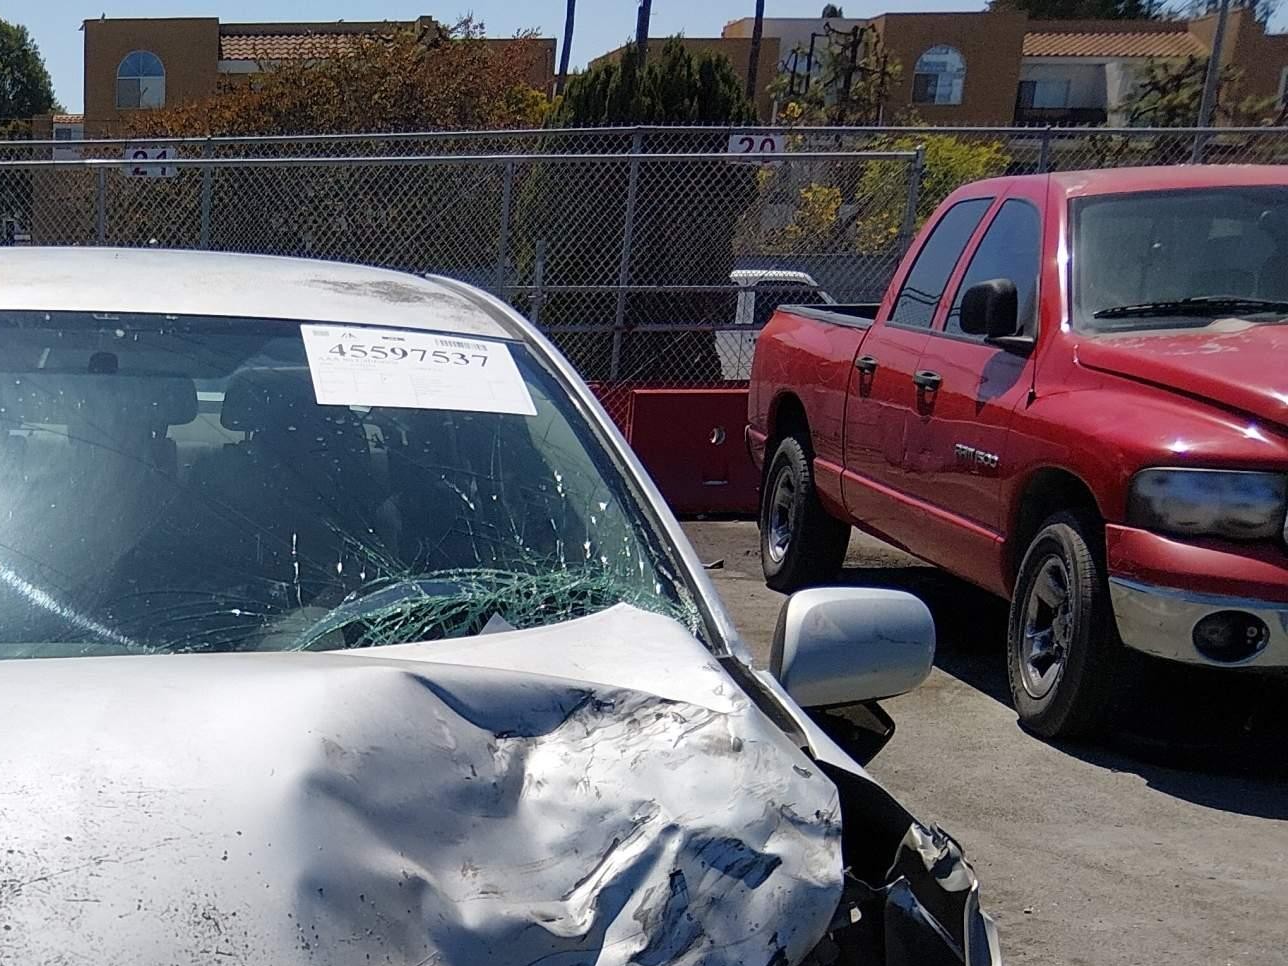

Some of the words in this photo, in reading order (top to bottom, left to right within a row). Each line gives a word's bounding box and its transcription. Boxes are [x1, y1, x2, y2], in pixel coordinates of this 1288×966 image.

[738, 136, 776, 163] 20
[133, 150, 168, 176] 21
[328, 343, 489, 368] 45597537
